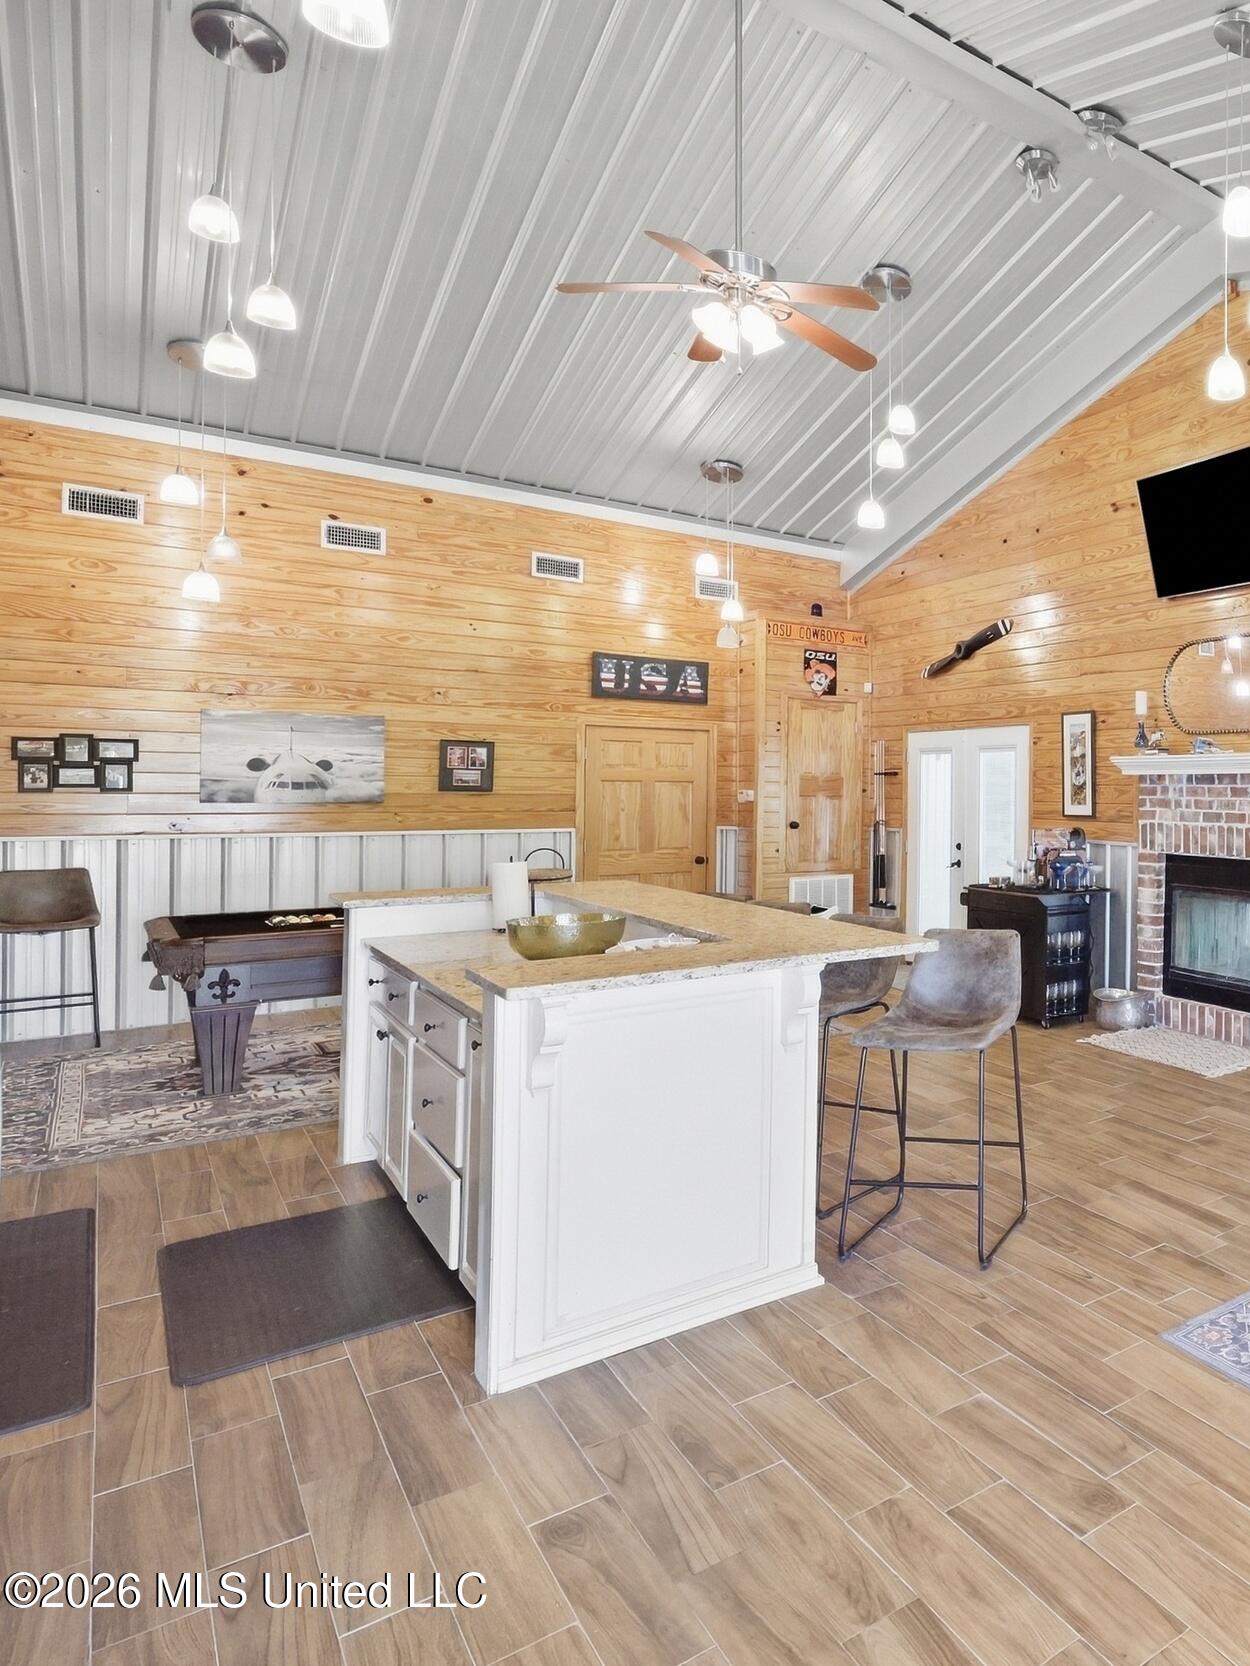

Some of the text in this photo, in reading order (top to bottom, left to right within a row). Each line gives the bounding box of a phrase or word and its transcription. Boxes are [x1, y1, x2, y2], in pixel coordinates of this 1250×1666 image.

[772, 623, 792, 637] OSU
[799, 626, 845, 644] COWBOYS
[805, 650, 836, 660] OSU
[599, 658, 704, 697] USA
